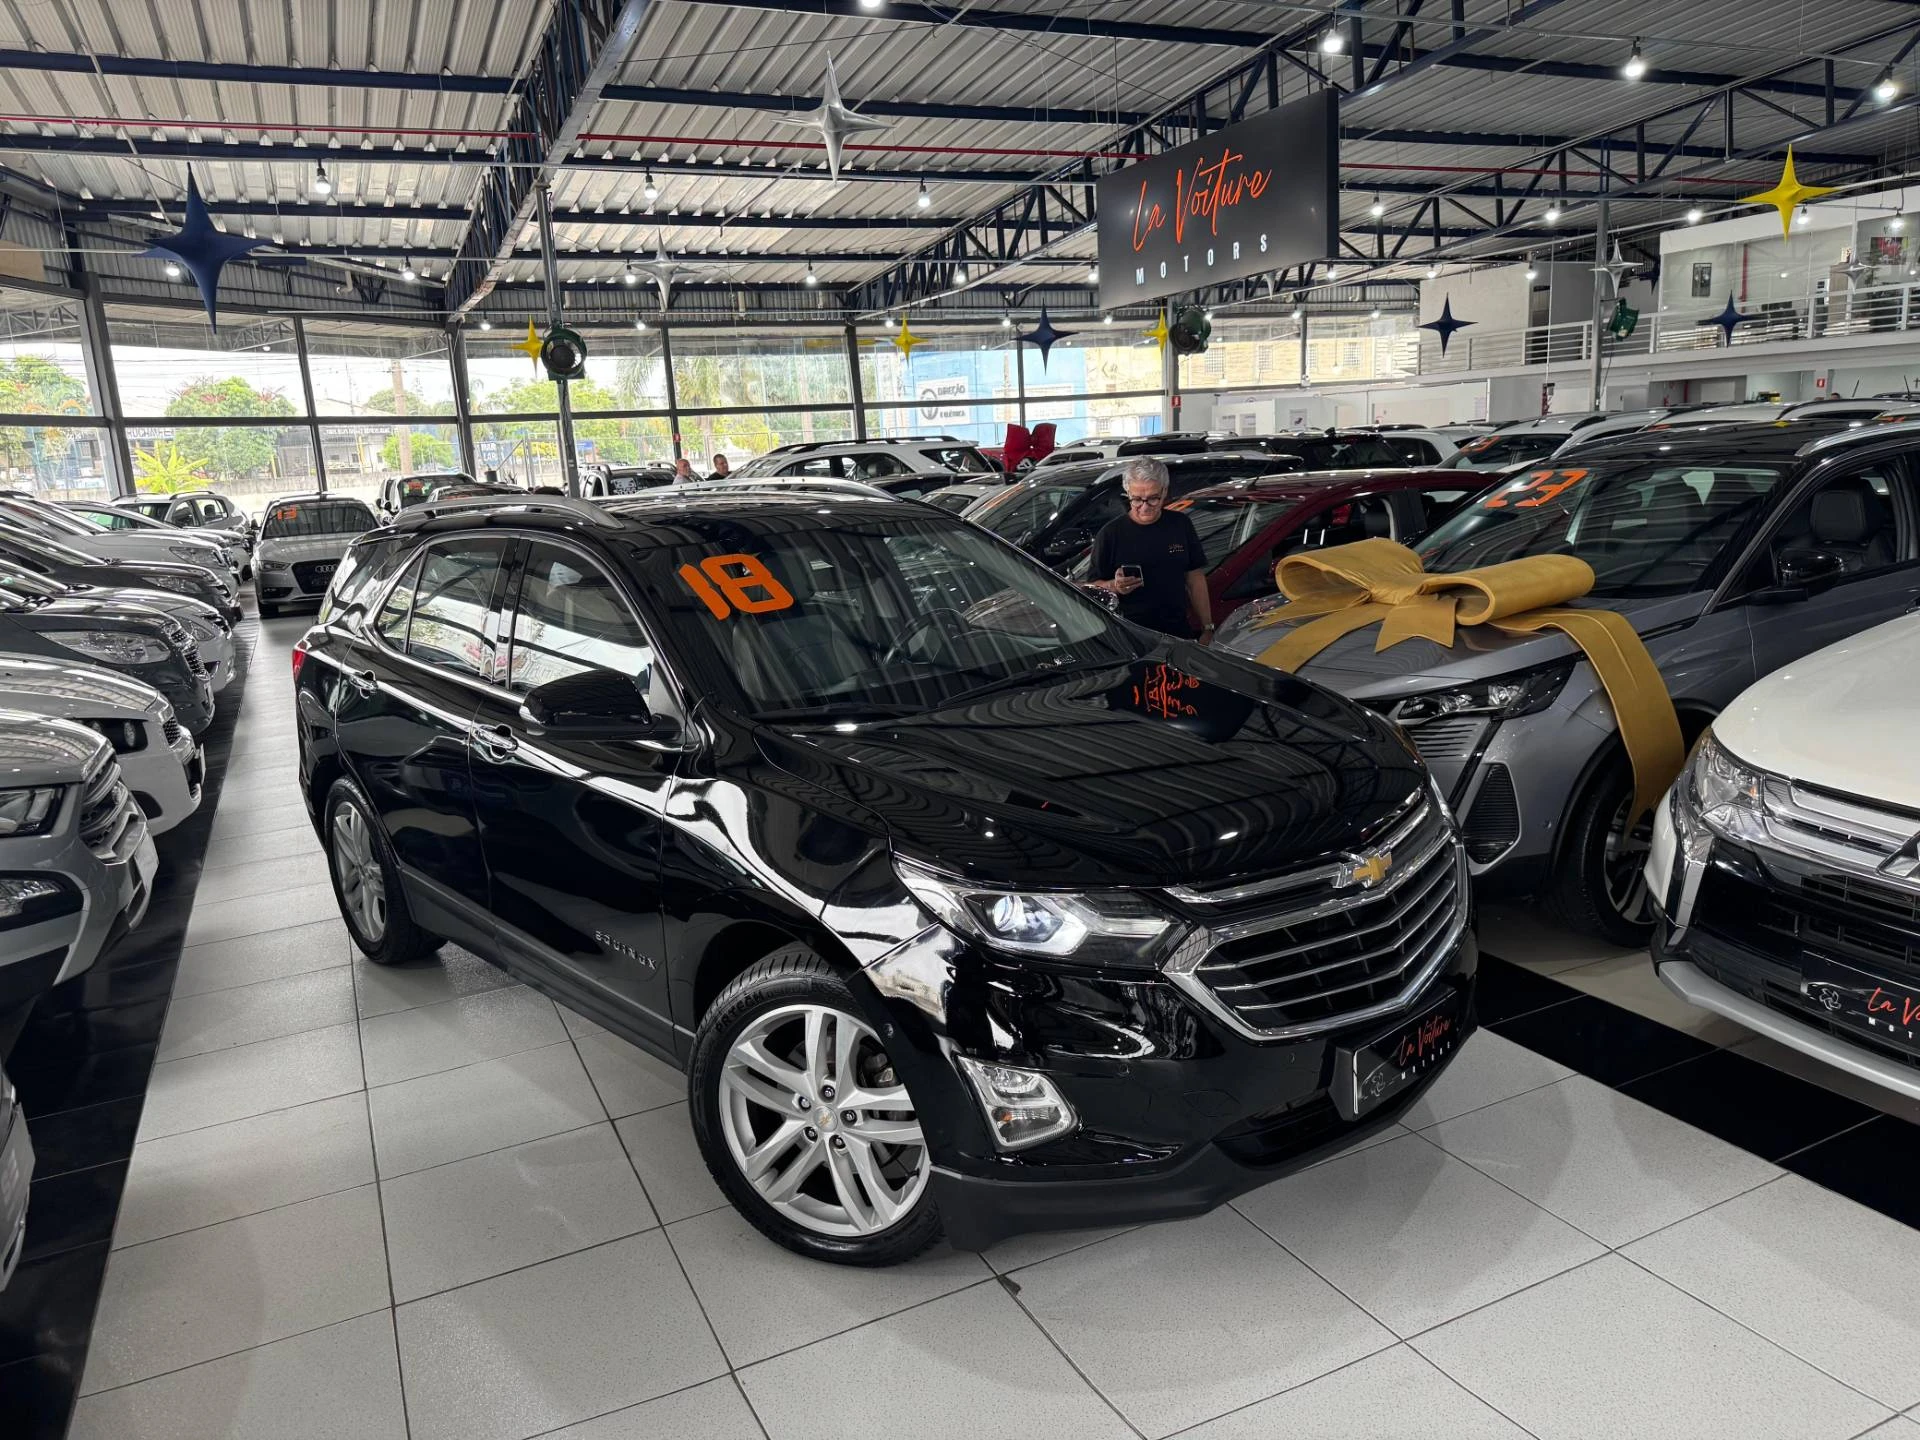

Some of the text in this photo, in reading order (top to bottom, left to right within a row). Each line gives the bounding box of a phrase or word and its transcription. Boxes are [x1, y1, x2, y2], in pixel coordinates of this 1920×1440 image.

[1133, 148, 1272, 252] La Voiture
[1135, 233, 1267, 286] MOTORS
[1484, 469, 1589, 508] 23
[679, 553, 795, 620] 18
[595, 929, 657, 970] EQUINOX
[1868, 987, 1897, 1012] La
[1400, 1015, 1452, 1067] La Voiture
